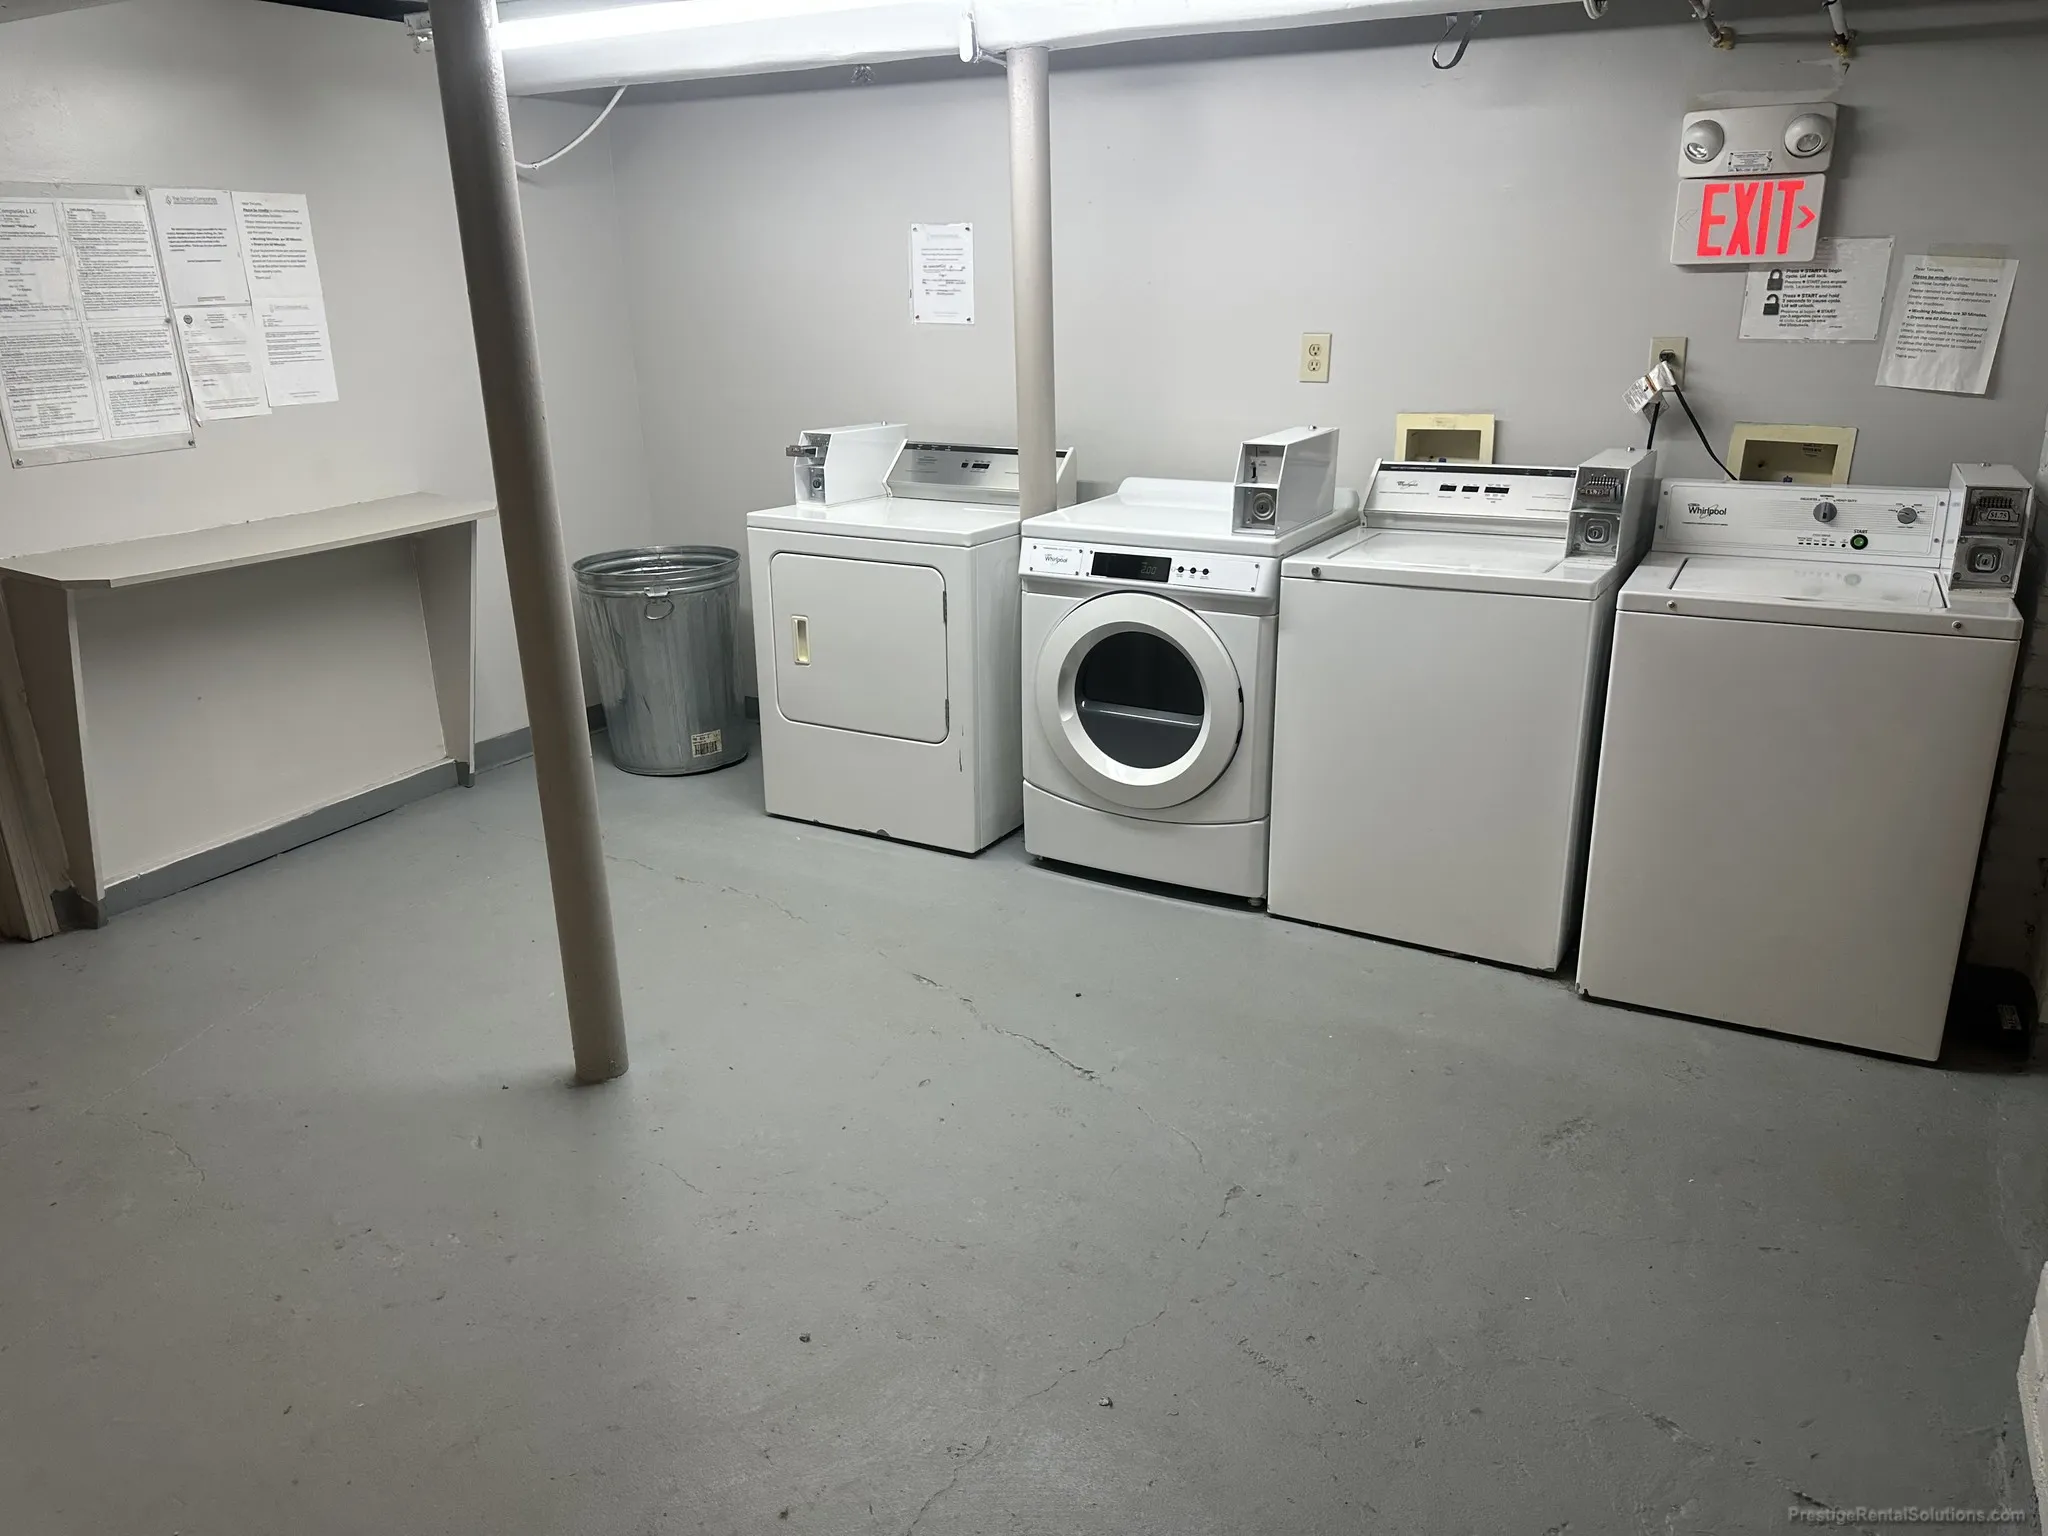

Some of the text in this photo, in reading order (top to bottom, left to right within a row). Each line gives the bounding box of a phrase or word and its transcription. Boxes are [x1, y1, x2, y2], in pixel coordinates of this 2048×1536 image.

[1697, 180, 1805, 256] EXIT
[1688, 506, 1727, 517] Whirlpool
[1990, 511, 2007, 519] $1.75
